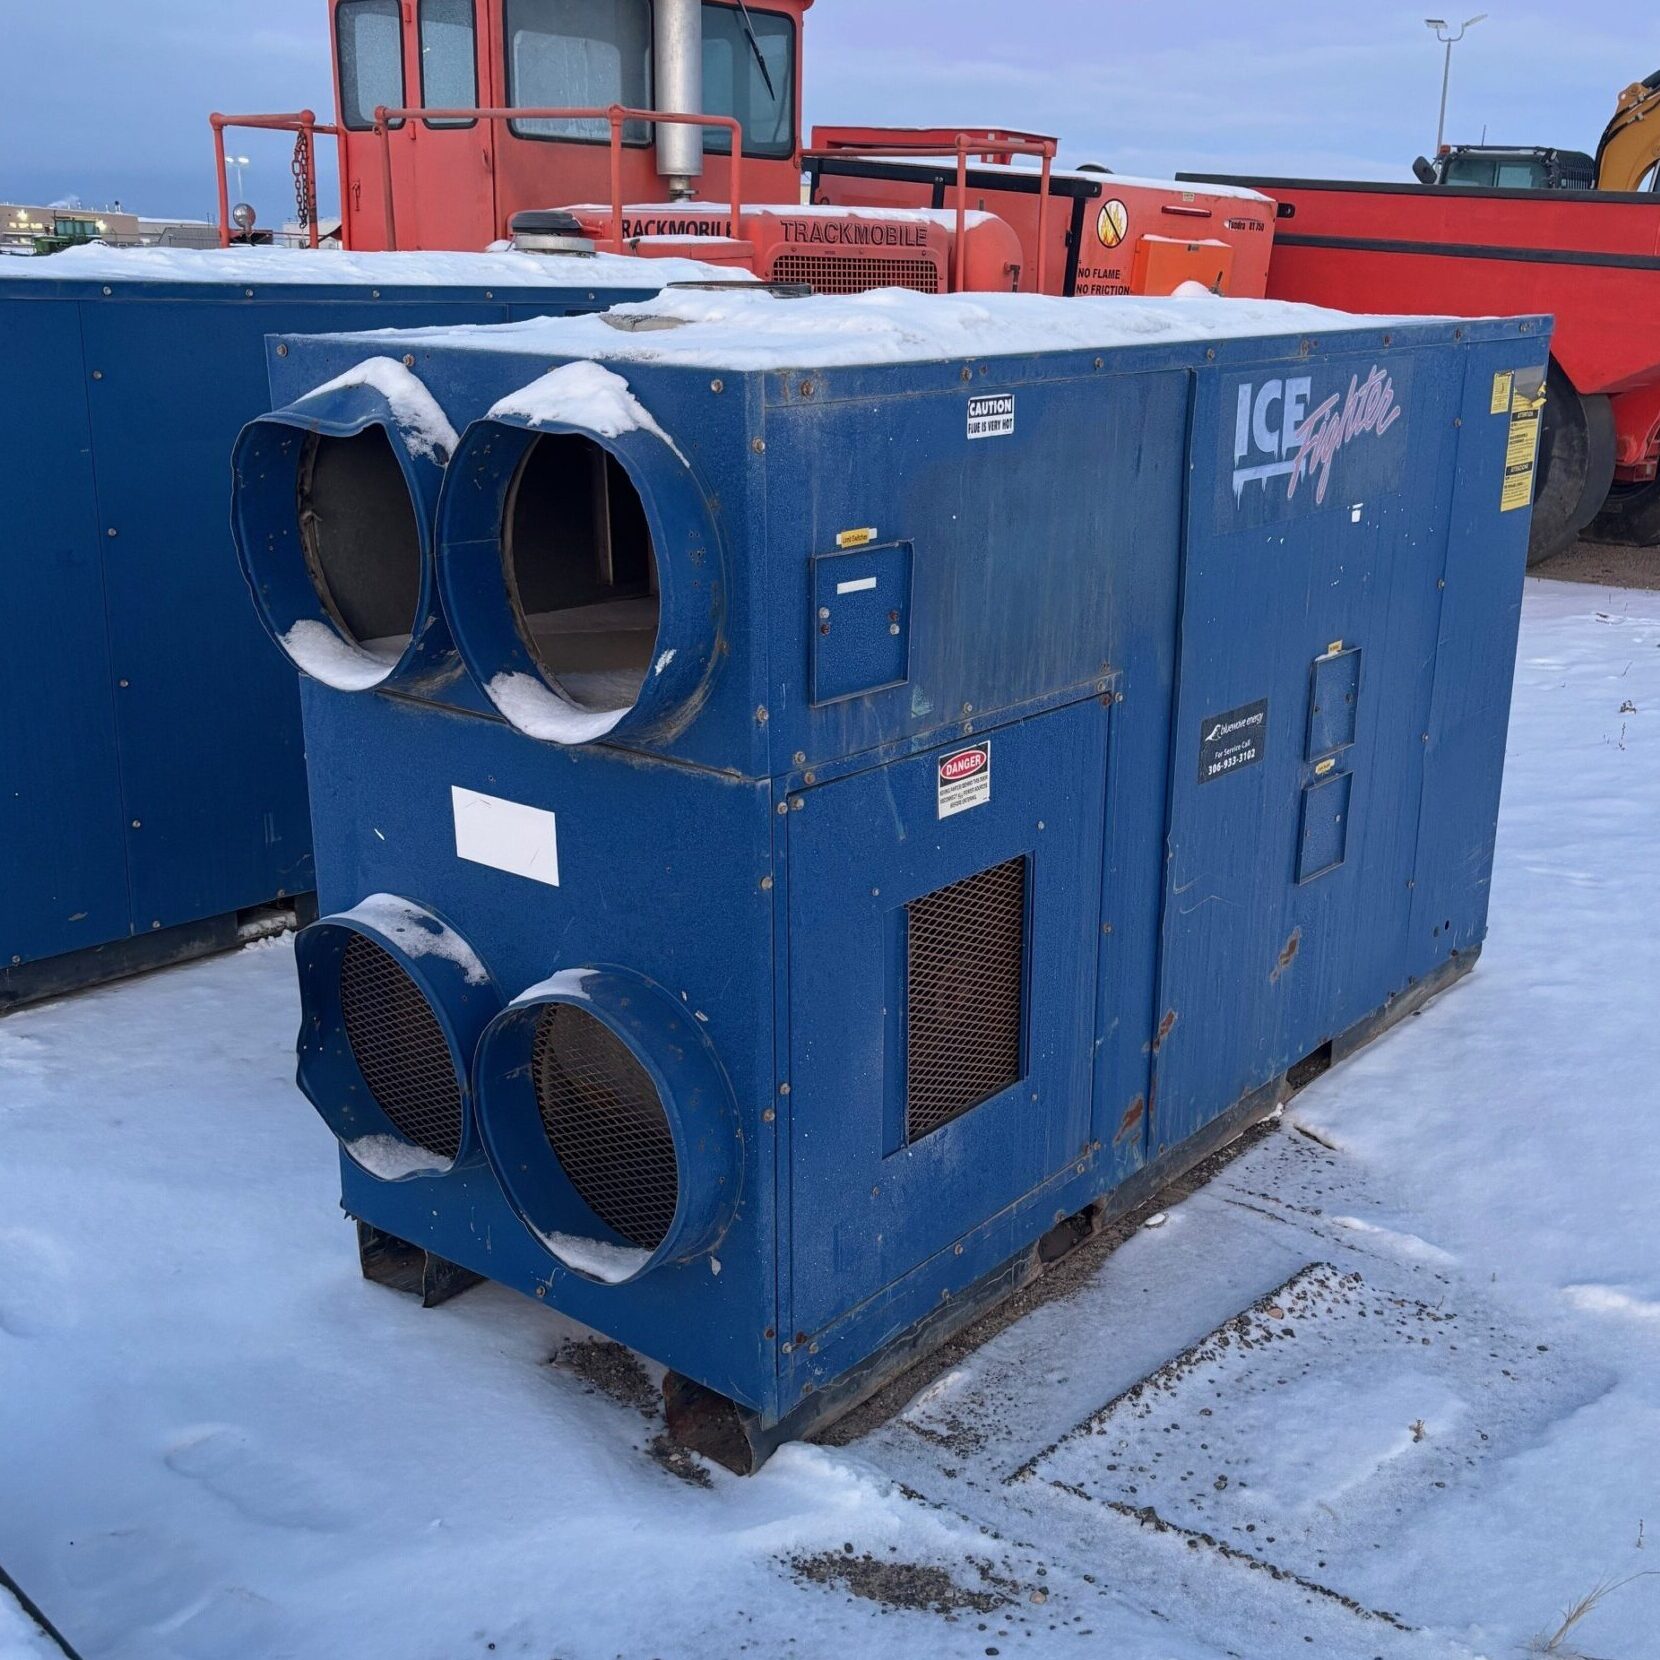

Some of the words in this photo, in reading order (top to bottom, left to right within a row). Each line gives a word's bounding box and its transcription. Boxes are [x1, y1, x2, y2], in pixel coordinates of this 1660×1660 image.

[621, 219, 732, 238] RACKMOBIL
[780, 219, 928, 247] TRACKMOBILE
[1077, 268, 1090, 278] NO
[1092, 268, 1120, 279] FLAME
[1076, 284, 1088, 295] NO
[1090, 284, 1130, 296] FRICTION
[969, 398, 1012, 417] CAUTION
[981, 421, 987, 432] IS
[988, 419, 1001, 431] VERY
[1002, 418, 1013, 430] HOT
[1234, 376, 1312, 464] ICE
[1287, 364, 1401, 504] Fighter
[1214, 751, 1223, 759] For
[1224, 744, 1241, 756] Service
[1241, 739, 1251, 749] Call
[946, 754, 981, 776] DANGER
[1208, 748, 1256, 775] 306-933-3102
